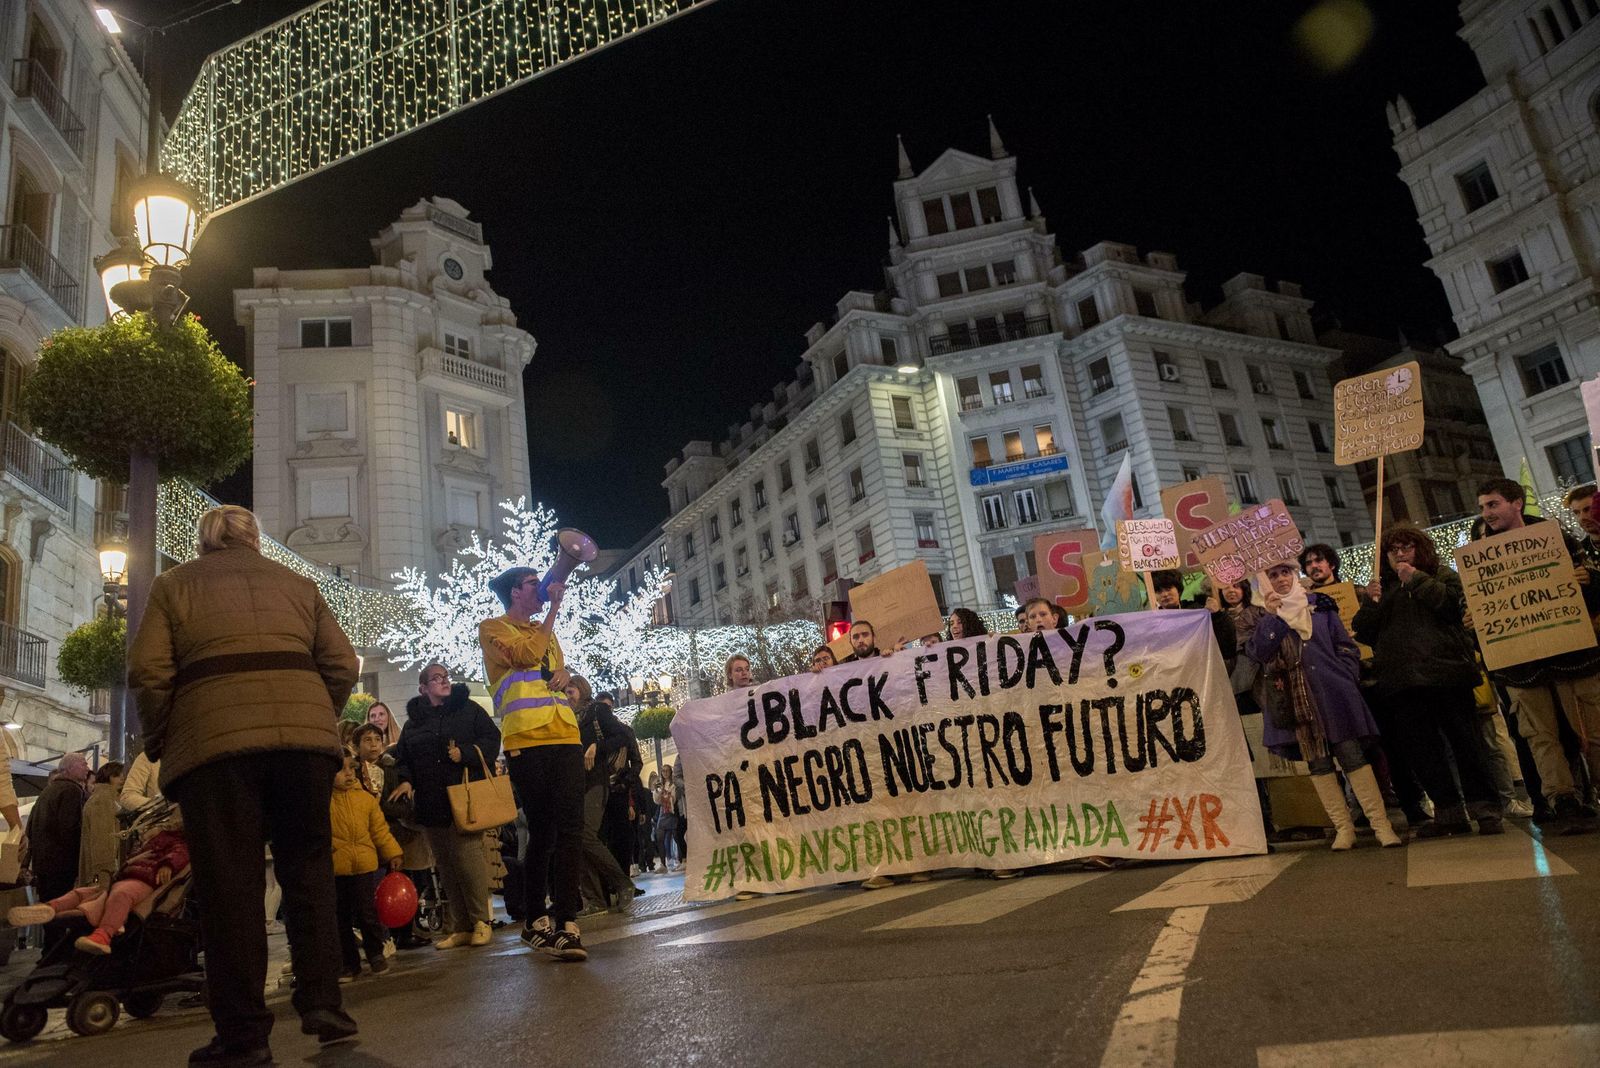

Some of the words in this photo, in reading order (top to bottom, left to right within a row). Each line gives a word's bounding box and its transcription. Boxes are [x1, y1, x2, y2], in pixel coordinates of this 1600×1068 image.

[1128, 520, 1173, 532] DESCUENTO
[1235, 513, 1290, 548] LLENAS
[1206, 537, 1277, 576] MENTES
[1462, 544, 1501, 569] BLACK
[1504, 536, 1555, 555] FRIDAY:
[1478, 564, 1505, 580] PARA
[1505, 559, 1519, 571] LAS
[1471, 581, 1505, 598] -40%
[1507, 568, 1550, 587] ANFIBIOS
[1476, 599, 1509, 617] -33%
[1510, 582, 1577, 611] CORALES
[1478, 616, 1519, 636] -25%
[1521, 605, 1581, 627] MAMÍFEROS
[740, 690, 895, 750] ¿BLACK
[915, 620, 1125, 705] FRIDAY?
[758, 739, 873, 823] NEGRO
[878, 711, 1033, 797] NUESTRO
[1039, 687, 1207, 782] FUTURO
[703, 800, 1130, 892] #FRIDAYSFORFUTUREGRANADA
[1137, 793, 1231, 852] #XR
